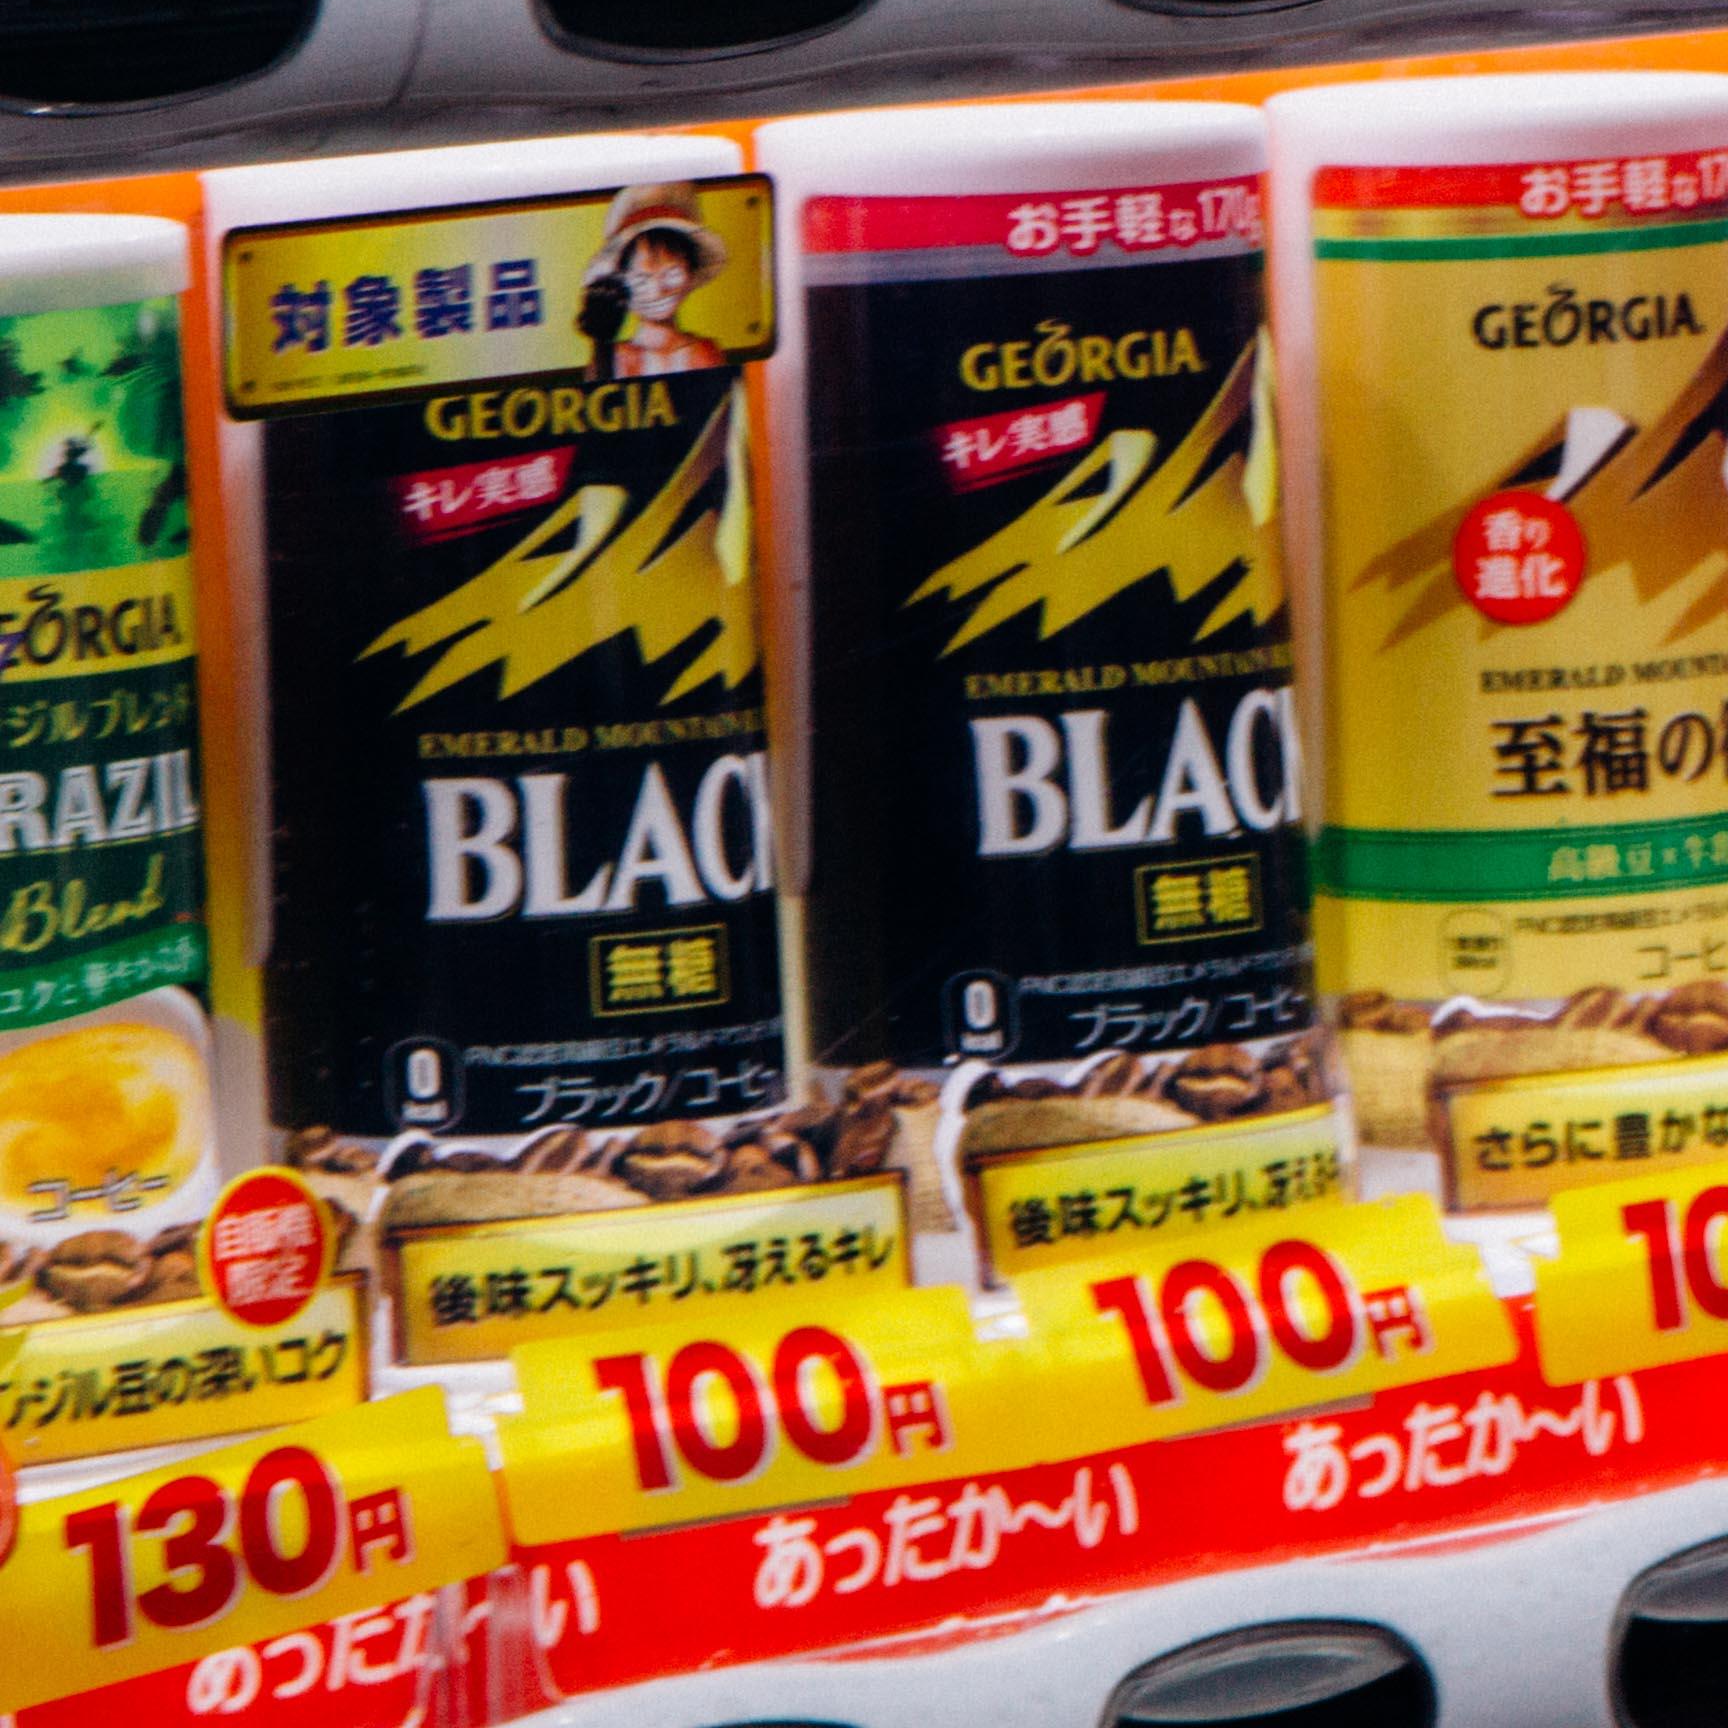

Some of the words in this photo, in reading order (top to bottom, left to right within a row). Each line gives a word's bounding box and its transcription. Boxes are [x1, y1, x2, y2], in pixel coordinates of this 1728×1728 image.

[270, 258, 545, 356] 対象製品
[1472, 280, 1706, 351] GEORGIA
[959, 317, 1204, 393] GEORGIA
[424, 380, 679, 443] GEORGIA
[1482, 512, 1551, 553] 香り
[1476, 559, 1569, 601] 進化
[965, 660, 1127, 700] EMERALD
[1480, 661, 1627, 696] EMERALD
[418, 726, 589, 759] EMERALD
[970, 685, 1300, 858] BLAC
[420, 753, 775, 922] BLAC
[0, 852, 166, 954] Blend
[1152, 867, 1252, 930] 無糖
[607, 938, 716, 1001] 無糖
[28, 1167, 171, 1224] コーヒー
[1089, 1238, 1434, 1410] 100円
[593, 1325, 955, 1494] 100円
[64, 1445, 412, 1651] 130円
